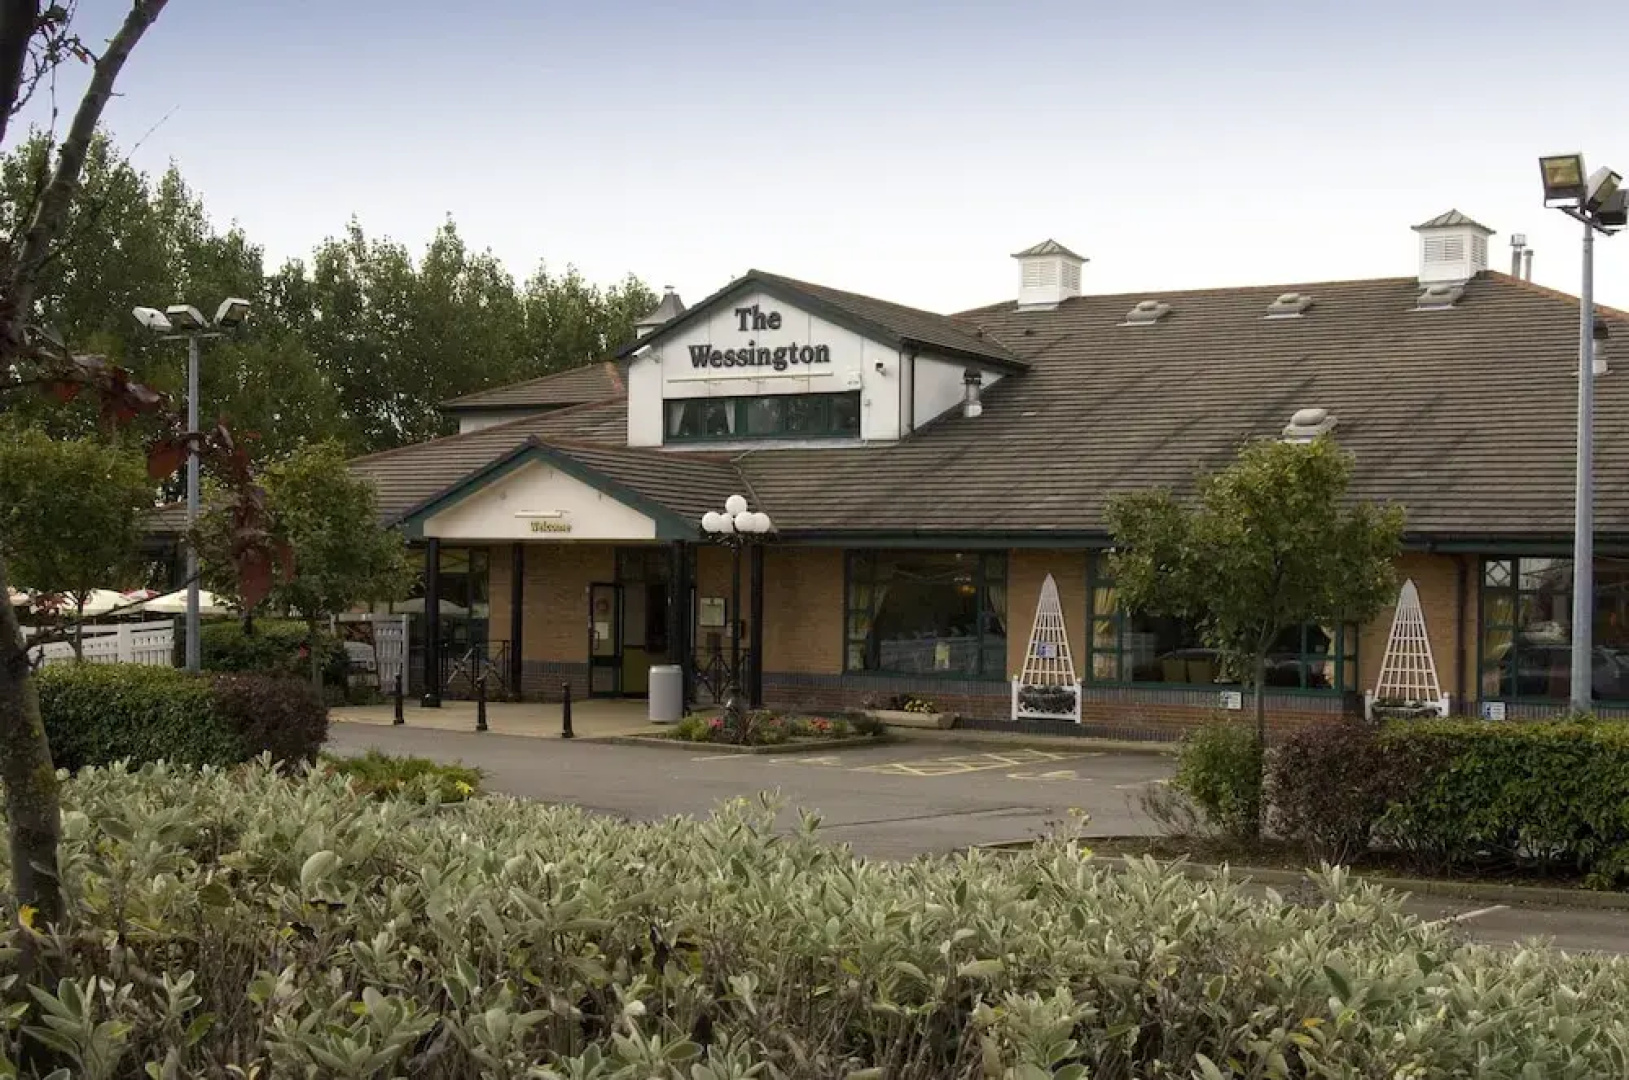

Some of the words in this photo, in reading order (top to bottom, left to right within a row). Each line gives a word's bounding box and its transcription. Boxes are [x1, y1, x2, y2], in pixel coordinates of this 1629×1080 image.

[735, 304, 782, 332] The
[688, 339, 831, 371] Wessington
[530, 520, 573, 533] Welcome
